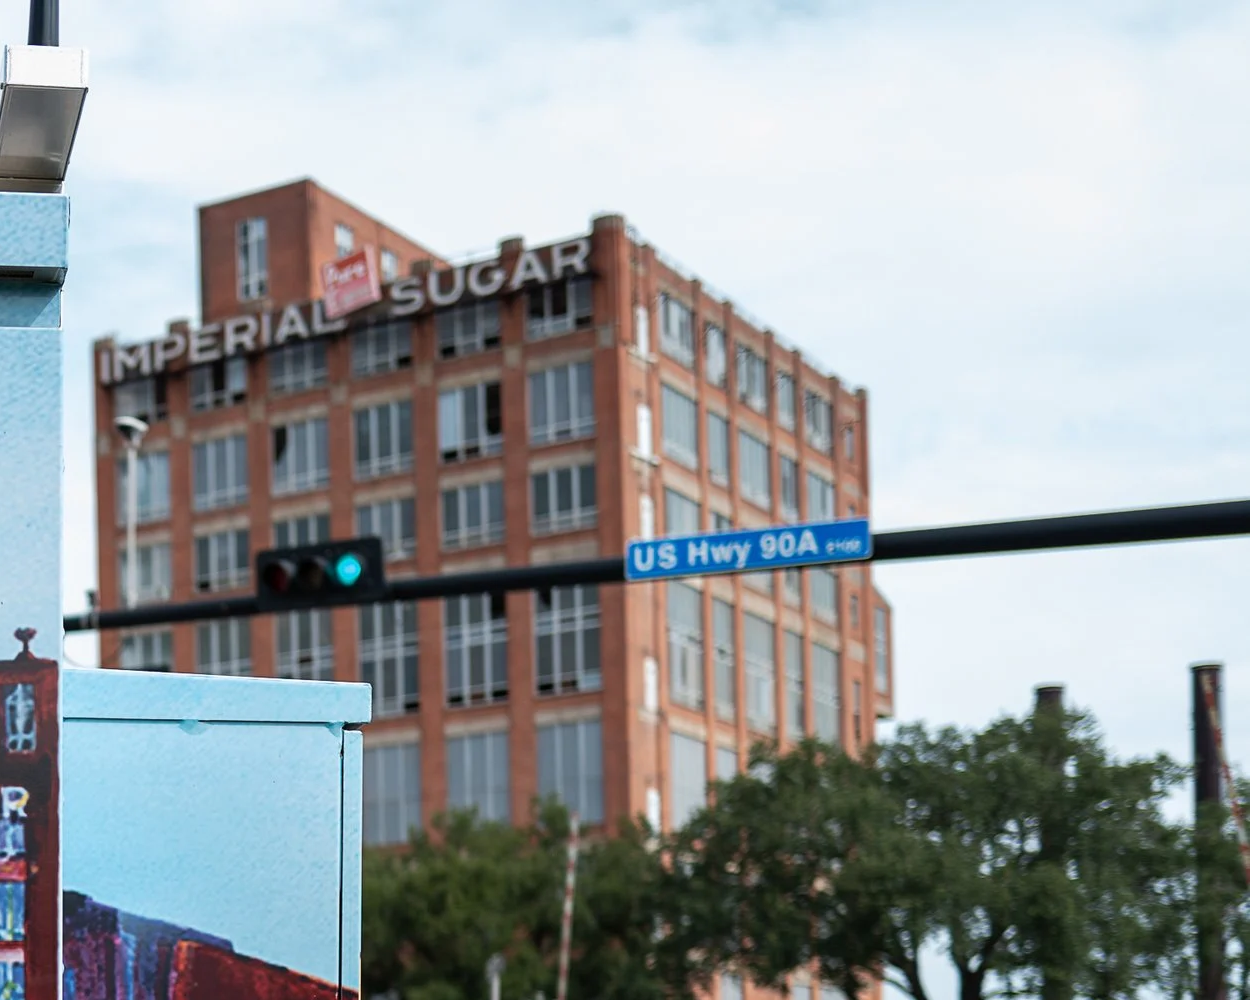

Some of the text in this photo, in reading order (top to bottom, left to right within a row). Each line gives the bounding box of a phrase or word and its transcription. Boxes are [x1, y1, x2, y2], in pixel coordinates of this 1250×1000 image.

[100, 237, 591, 384] IMPERIAL SUGAR
[634, 545, 678, 571] US
[687, 540, 752, 568] Hwy
[759, 529, 819, 559] 90A
